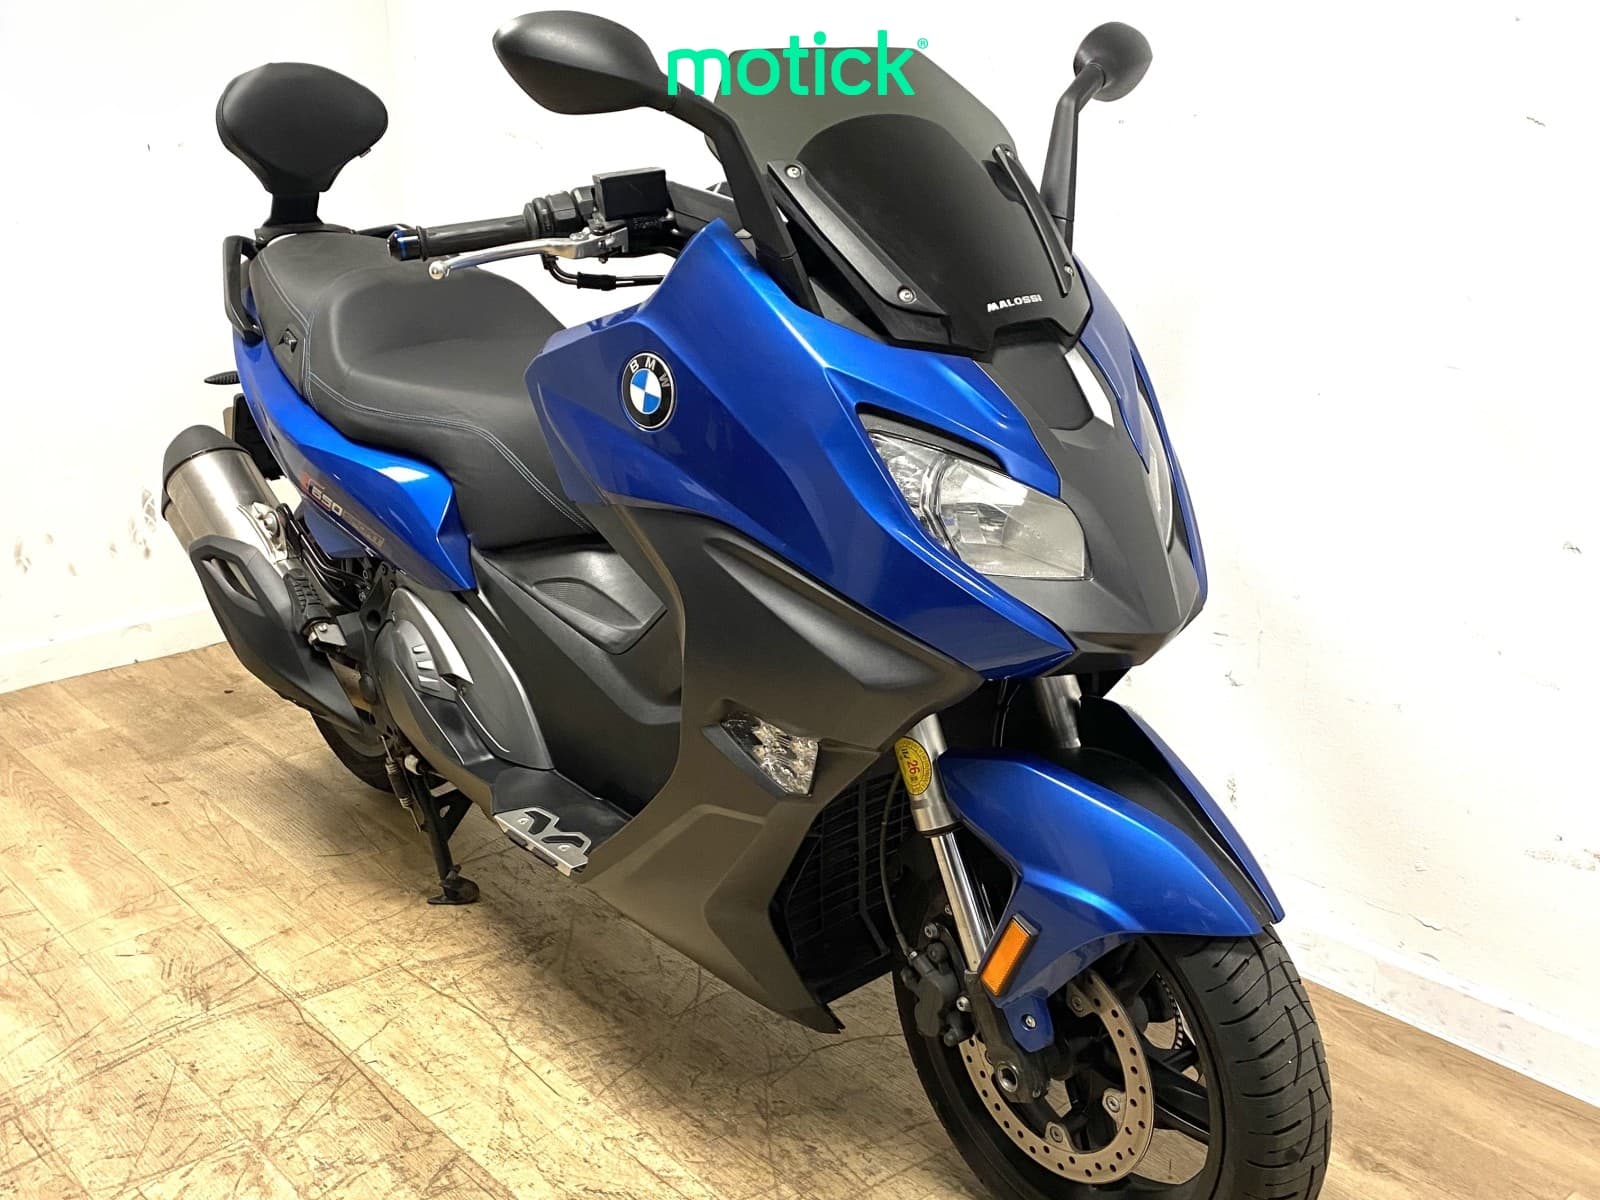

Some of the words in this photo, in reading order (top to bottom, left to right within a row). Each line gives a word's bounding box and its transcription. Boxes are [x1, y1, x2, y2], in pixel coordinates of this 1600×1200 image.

[987, 294, 1043, 313] MALOSSI
[629, 356, 671, 388] BMW
[907, 760, 920, 775] 26
